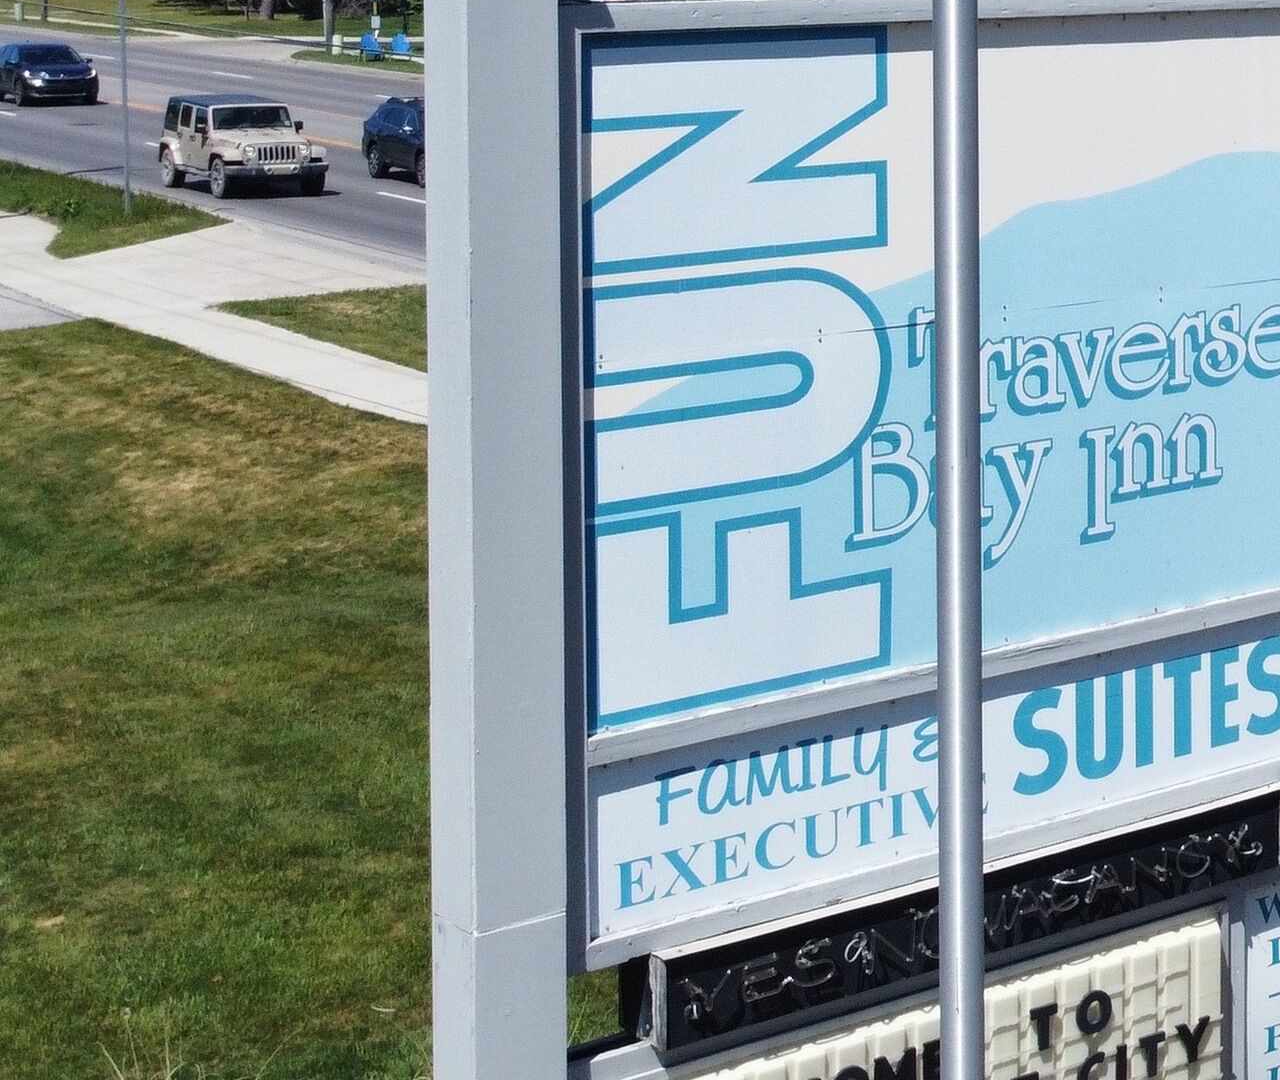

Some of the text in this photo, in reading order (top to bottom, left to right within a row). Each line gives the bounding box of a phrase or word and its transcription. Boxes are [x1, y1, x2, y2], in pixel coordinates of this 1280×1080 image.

[582, 26, 891, 734] FUN
[844, 412, 1223, 571] By Inn
[615, 774, 989, 911] EXECUTIV
[1029, 990, 1113, 1051] TO
[1076, 1015, 1211, 1080] CITY
